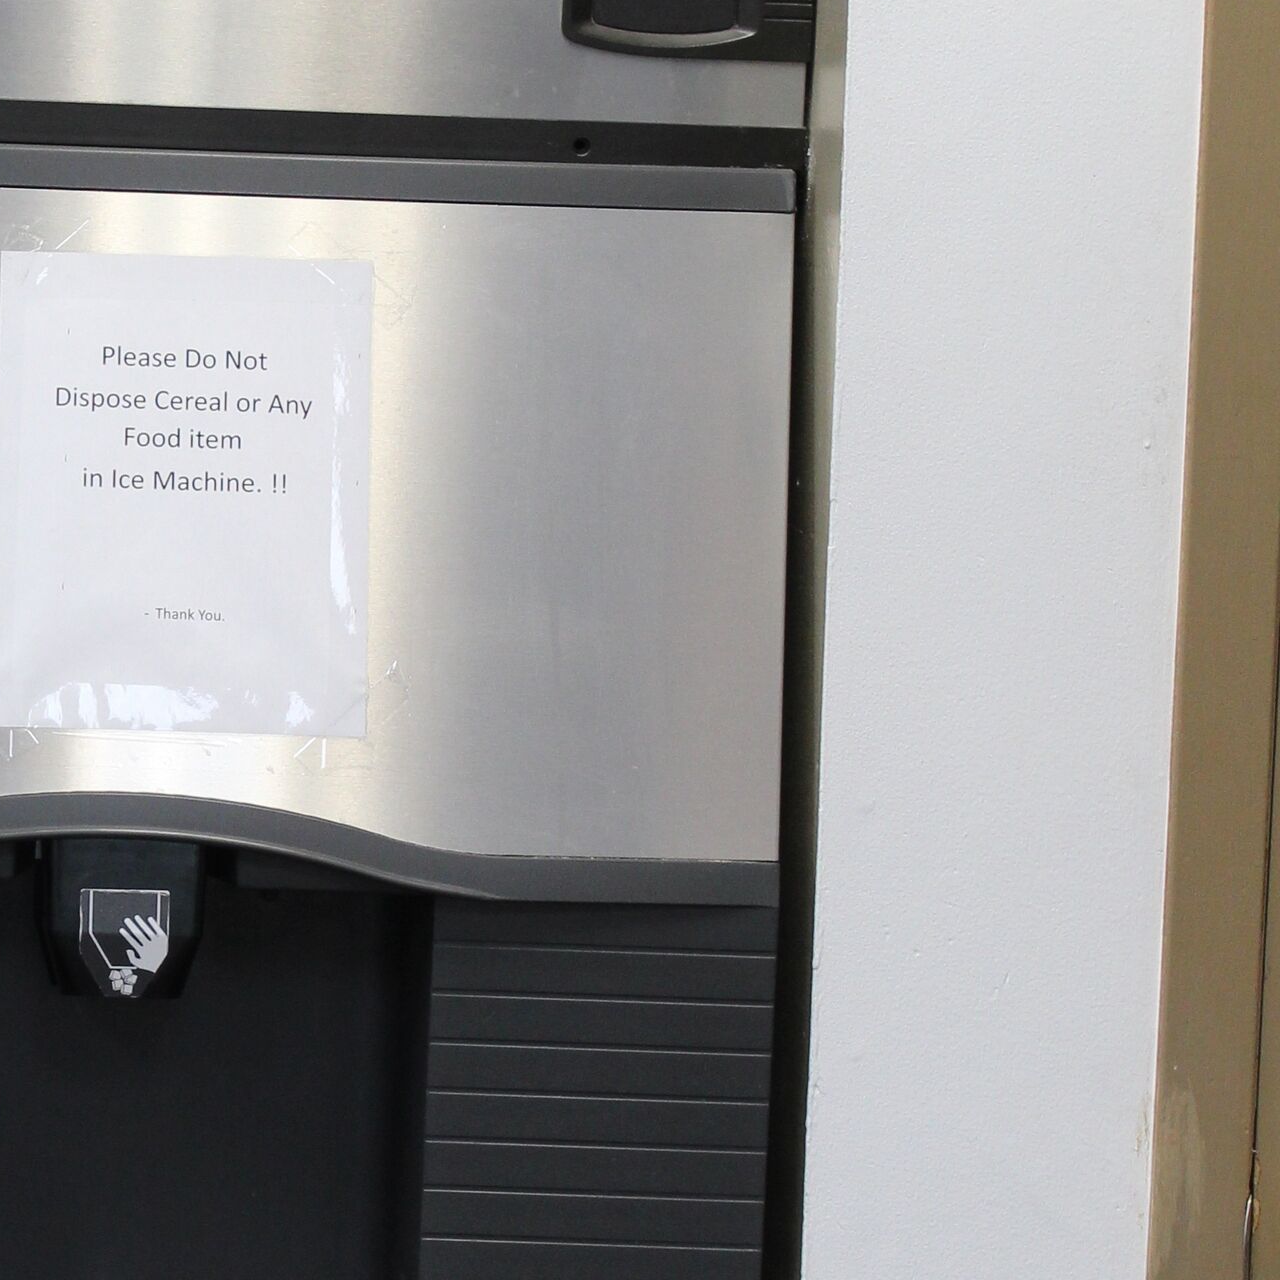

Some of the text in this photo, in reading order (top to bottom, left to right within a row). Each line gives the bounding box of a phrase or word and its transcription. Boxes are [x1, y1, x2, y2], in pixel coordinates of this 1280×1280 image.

[102, 346, 268, 371] Please Do Not
[56, 387, 313, 419] Dispose Cereal or Any
[124, 427, 242, 450] Food item
[82, 468, 288, 494] in Ice Machine. !!
[155, 607, 195, 621] Thank
[198, 609, 225, 622] You.
